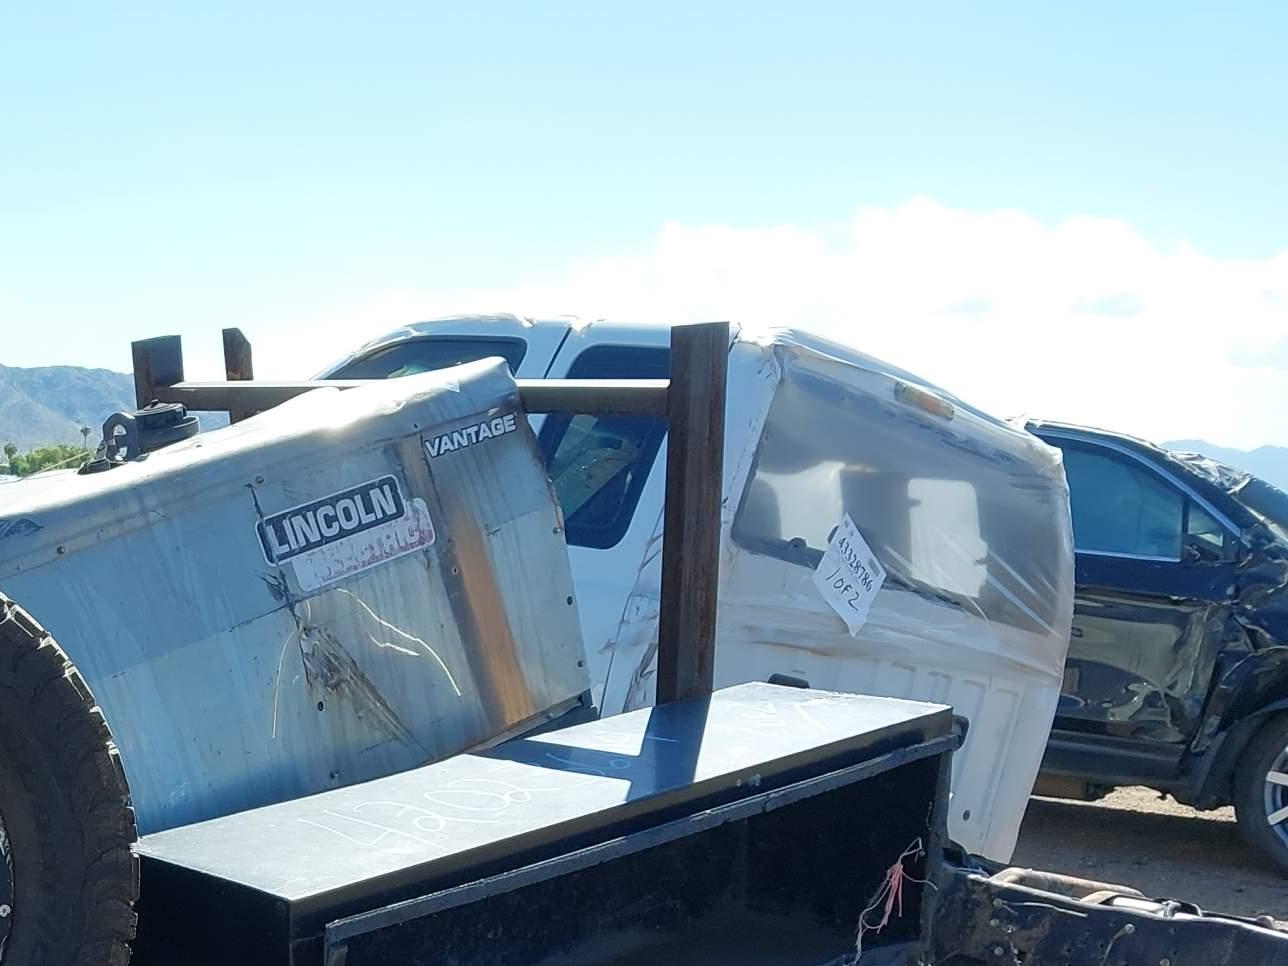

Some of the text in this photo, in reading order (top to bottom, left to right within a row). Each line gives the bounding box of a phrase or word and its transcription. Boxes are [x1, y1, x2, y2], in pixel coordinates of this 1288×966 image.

[424, 414, 517, 459] VANTAGE
[266, 484, 397, 555] LINCOLN
[838, 537, 873, 593] 43328786
[847, 591, 859, 612] 2
